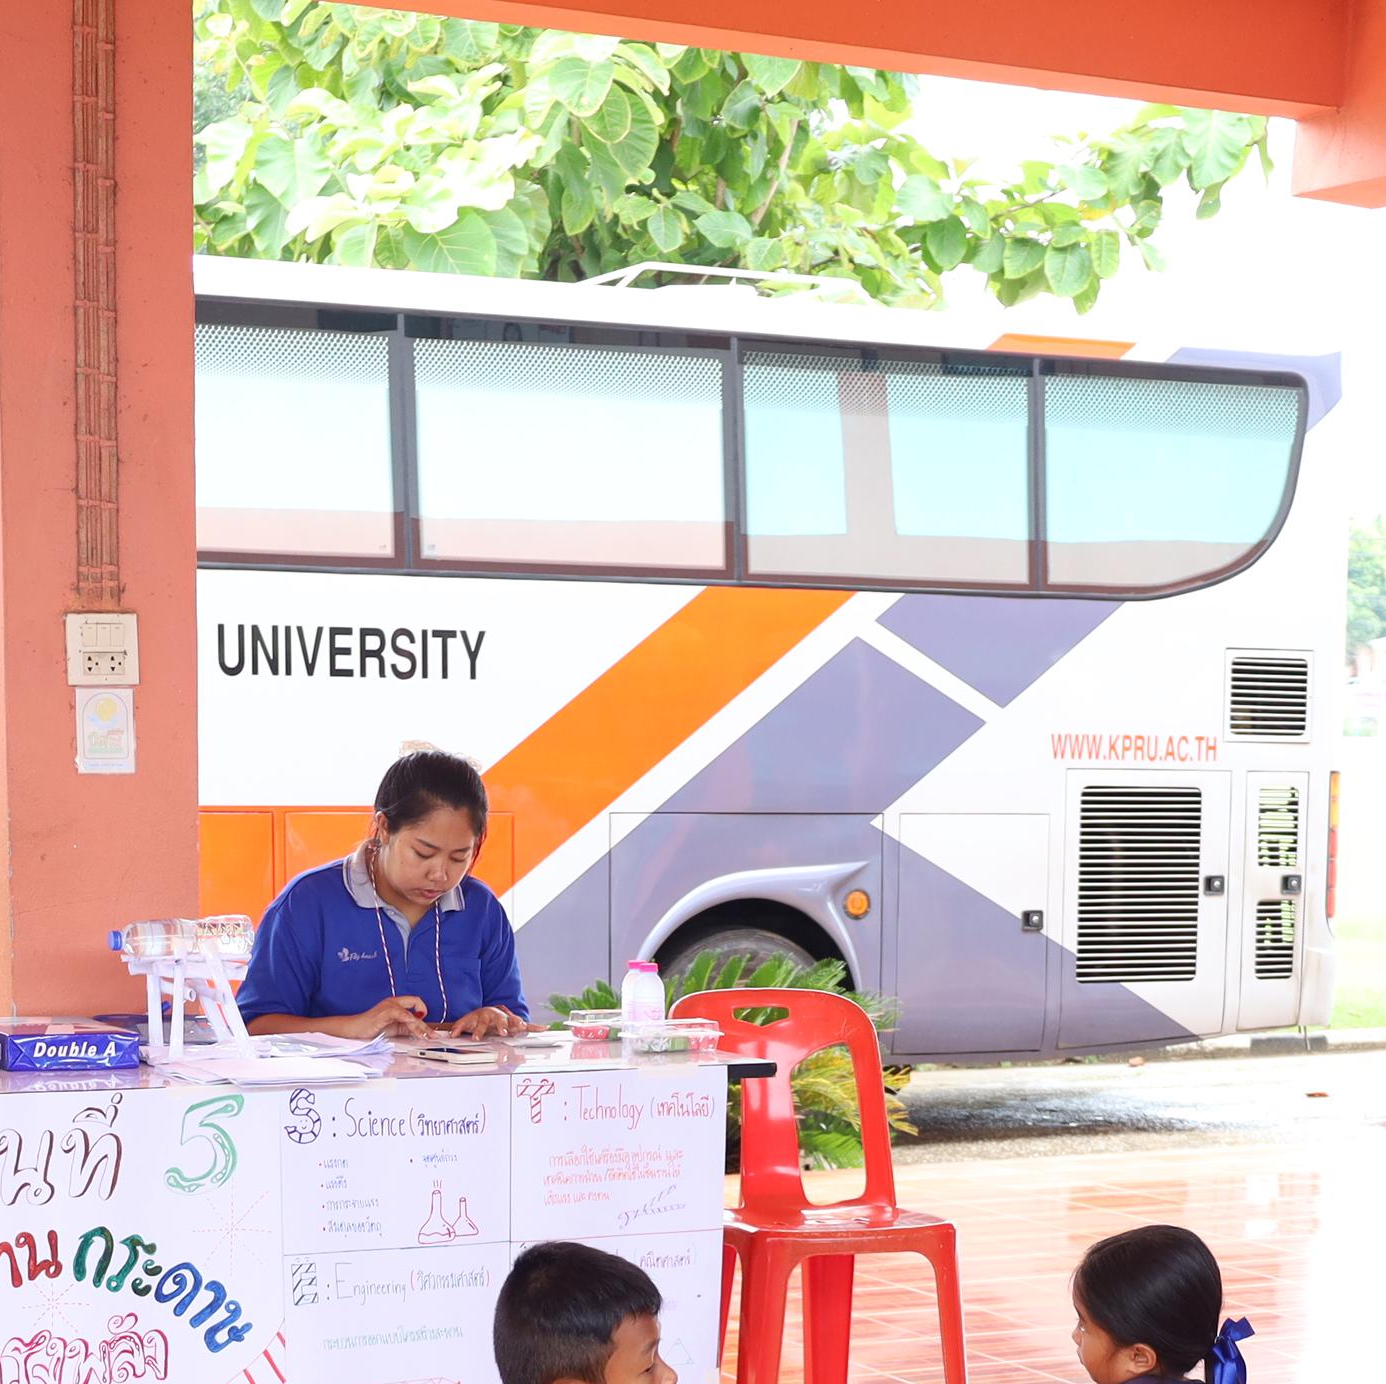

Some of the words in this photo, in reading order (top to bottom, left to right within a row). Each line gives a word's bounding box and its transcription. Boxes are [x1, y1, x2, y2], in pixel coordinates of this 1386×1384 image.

[217, 623, 486, 680] UNIVERSITY
[1051, 733, 1218, 762] WWW.KPRU.AC.TH
[33, 1041, 98, 1058] Double
[103, 1041, 117, 1057] A
[284, 1088, 322, 1144] S
[344, 1097, 406, 1138] Science
[516, 1078, 555, 1124] T
[571, 1083, 644, 1130] Technology
[164, 1094, 245, 1194] 5
[72, 1225, 253, 1353] กระดาษ
[291, 1261, 319, 1306] E
[335, 1262, 407, 1306] Engineering
